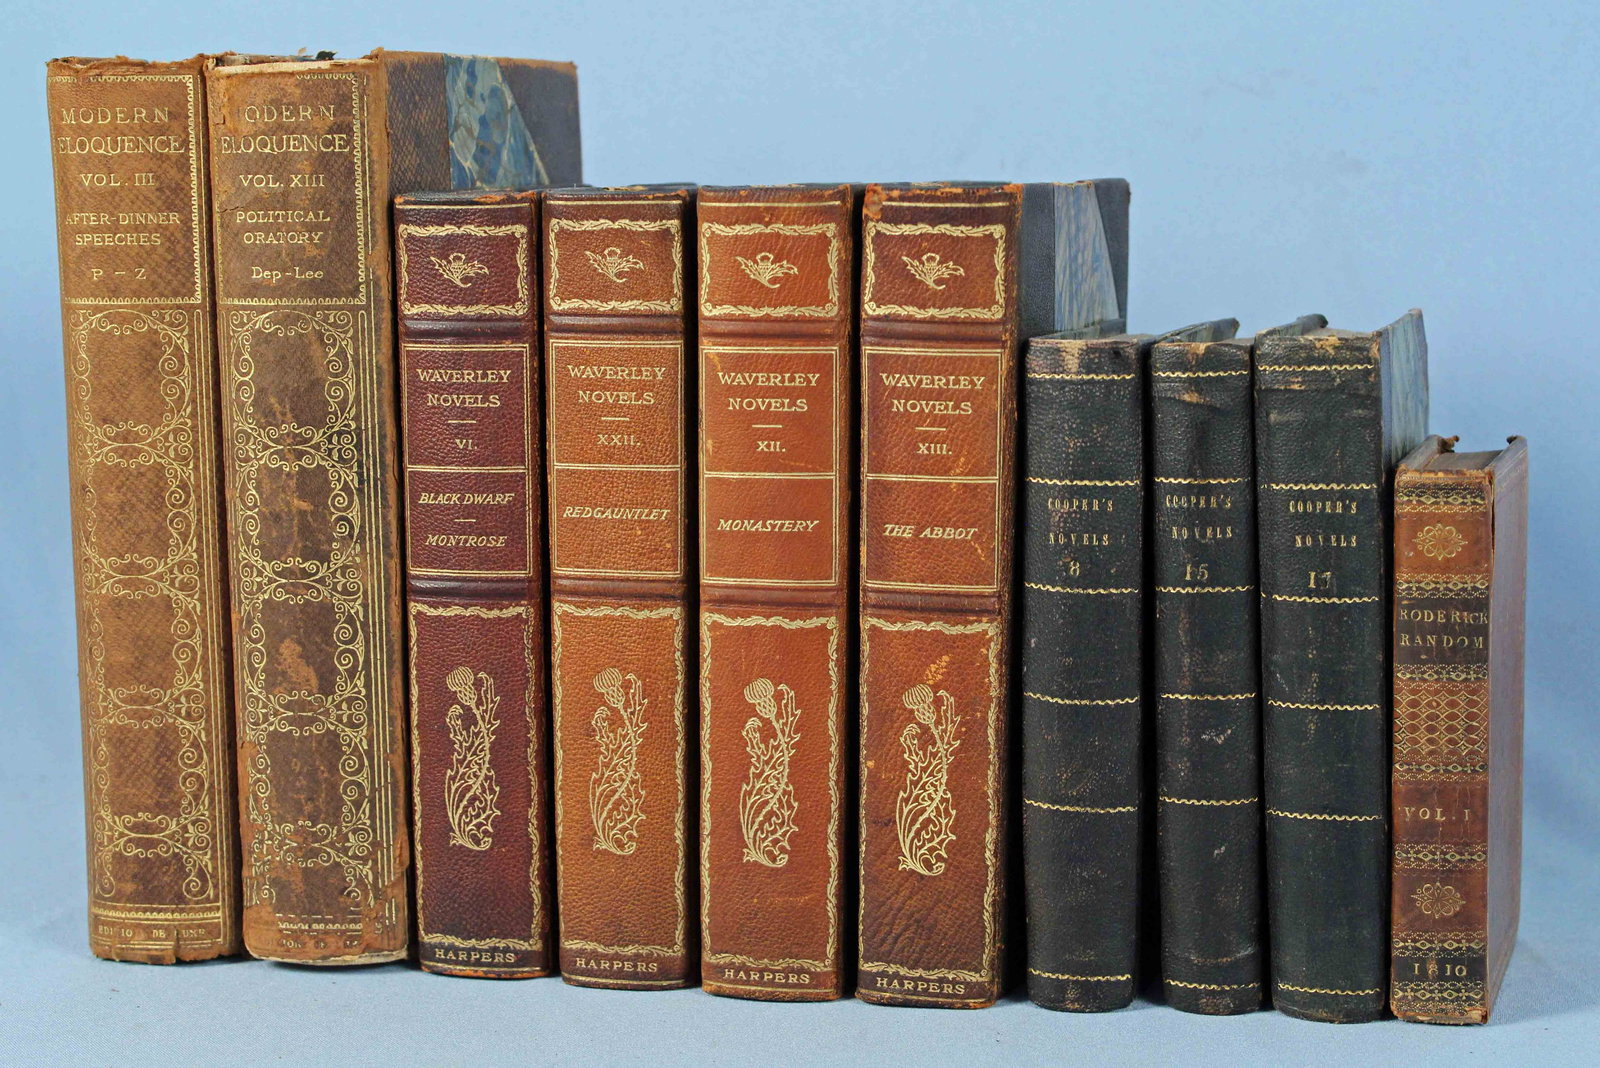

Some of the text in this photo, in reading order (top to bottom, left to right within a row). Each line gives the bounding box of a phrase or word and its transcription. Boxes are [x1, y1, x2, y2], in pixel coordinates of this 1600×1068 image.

[62, 107, 169, 124] MODERN
[237, 104, 335, 122] ODERN
[58, 135, 185, 155] ELOQUENCE
[221, 134, 350, 154] ELOQUENCE
[80, 172, 155, 186] VOL. III
[239, 174, 325, 187] VOL. XIII
[65, 212, 181, 225] AFTER-DINNER
[236, 210, 331, 223] POLITICAL
[75, 233, 162, 246] SPEECHES
[243, 231, 324, 244] ORATORY
[416, 368, 512, 383] WAVERLEY
[567, 364, 666, 380] WAVERLEY
[717, 372, 820, 387] WAVERLEY
[880, 373, 986, 389] WAVERLEY
[427, 394, 501, 407] NOVELS
[577, 390, 656, 405] NOVELS
[727, 398, 808, 412] NOVELS
[891, 399, 973, 415] NOVELS
[455, 439, 478, 450] VI.
[596, 434, 641, 446] XXII.
[756, 441, 786, 452] XII.
[916, 442, 953, 455] XIII.
[418, 492, 515, 504] BLACK DWARF
[1047, 498, 1114, 511] COOPER'S
[563, 506, 671, 520] REDGAUNTLET
[1289, 499, 1357, 514] COOPER'S
[717, 519, 820, 532] MONASTERY
[883, 524, 979, 540] THE ABBOT
[1171, 526, 1232, 539] NOVELS
[425, 534, 508, 547] MONTROSE
[1049, 532, 1109, 545] NOVELS
[1295, 534, 1357, 547] NOVELS
[1069, 560, 1080, 577] 8
[1185, 563, 1209, 581] 15
[1308, 571, 1332, 588] 17
[1399, 608, 1489, 624] RODERICK
[1400, 633, 1484, 649] RANDOM
[1403, 806, 1456, 821] VOL.
[435, 948, 516, 963] HARPERS
[575, 957, 659, 973] HARPERS
[722, 968, 811, 984] HARPERS
[875, 976, 967, 995] HARPERS
